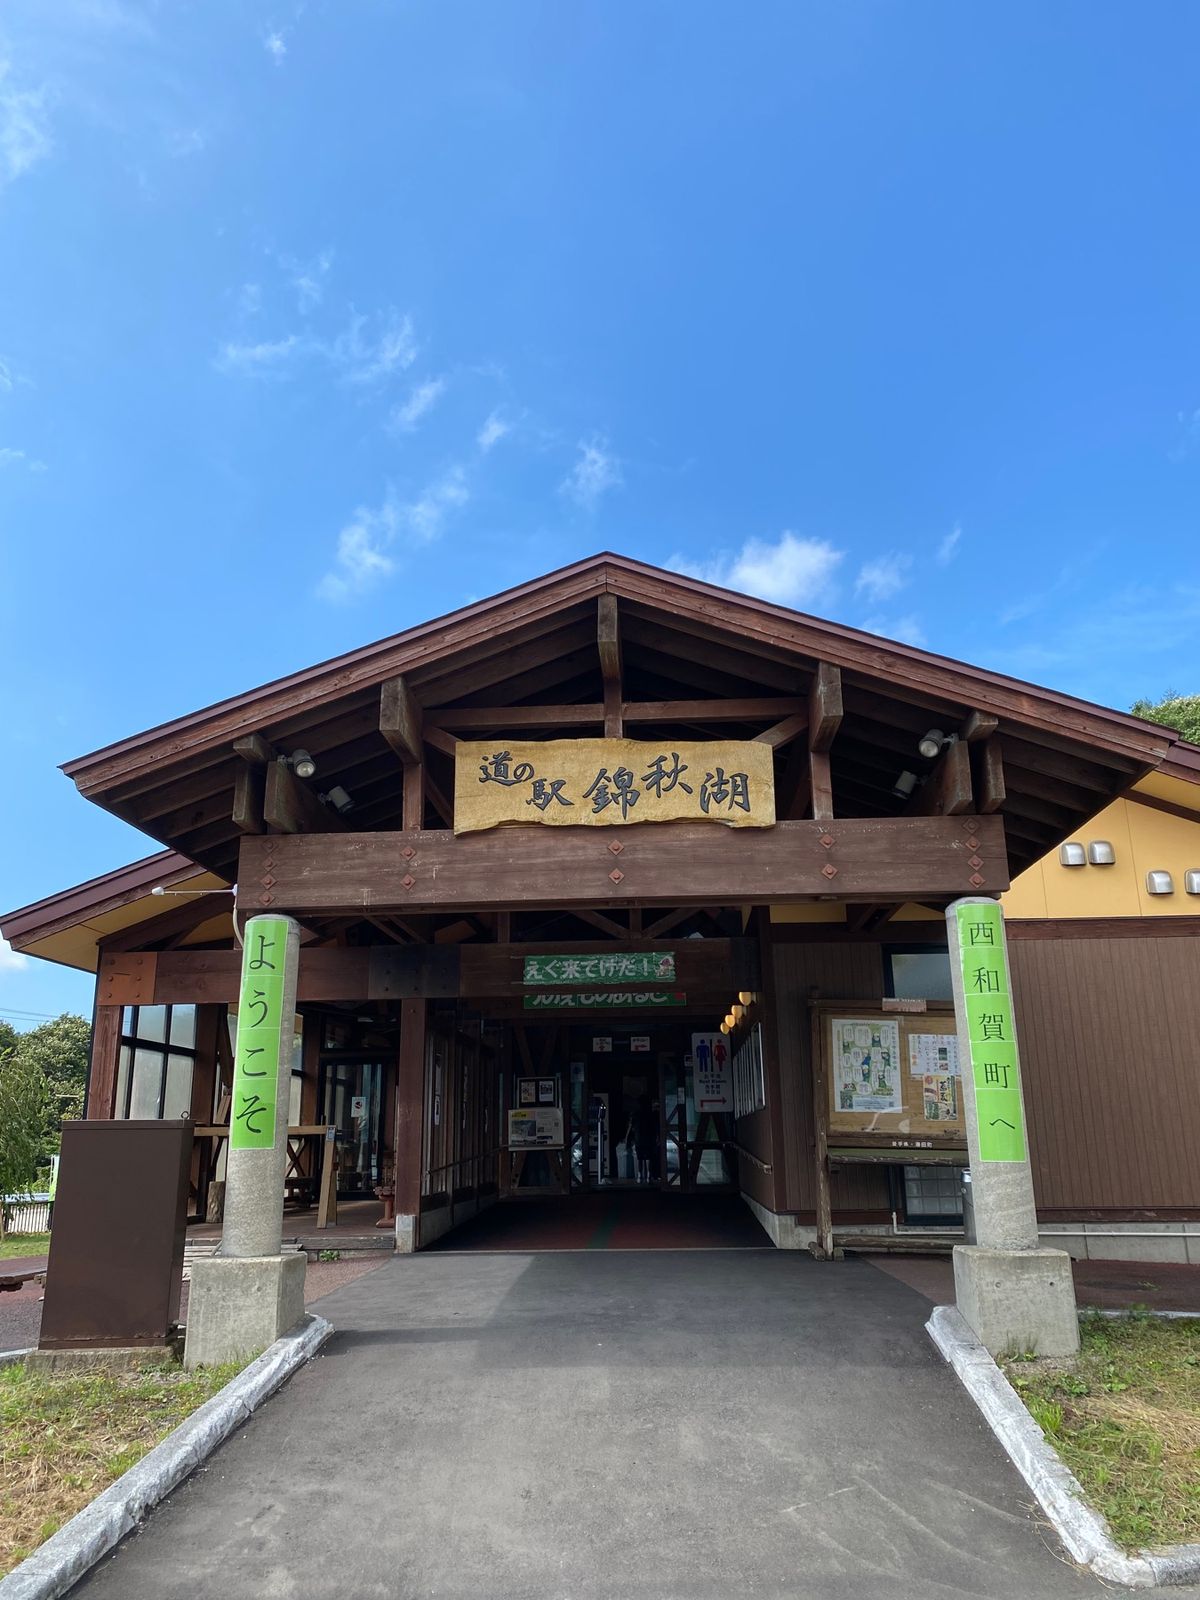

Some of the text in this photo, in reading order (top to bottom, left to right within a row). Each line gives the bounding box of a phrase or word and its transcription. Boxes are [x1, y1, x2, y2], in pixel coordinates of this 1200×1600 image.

[236, 934, 276, 1135] ようこそ
[967, 921, 1016, 1130] 西和賀町へ
